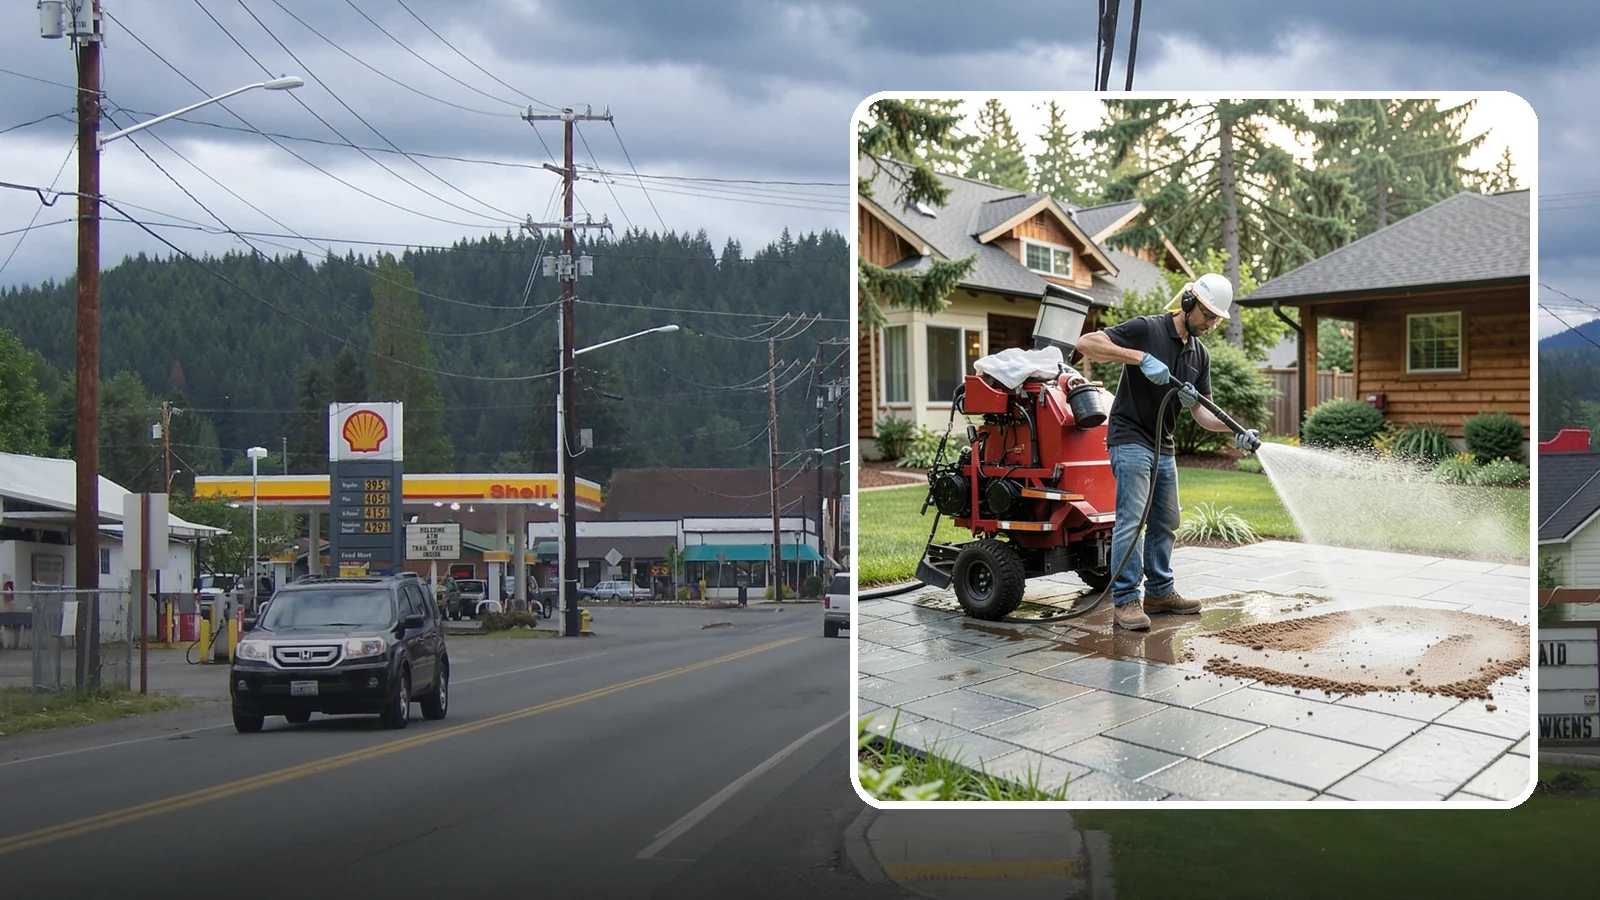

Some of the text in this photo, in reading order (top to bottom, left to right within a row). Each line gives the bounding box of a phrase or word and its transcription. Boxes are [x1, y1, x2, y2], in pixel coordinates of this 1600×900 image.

[366, 480, 383, 491] 395
[490, 484, 547, 499] Shell
[366, 494, 383, 505] 405
[366, 508, 383, 519] 415
[366, 522, 383, 533] 429
[1539, 643, 1566, 665] AID
